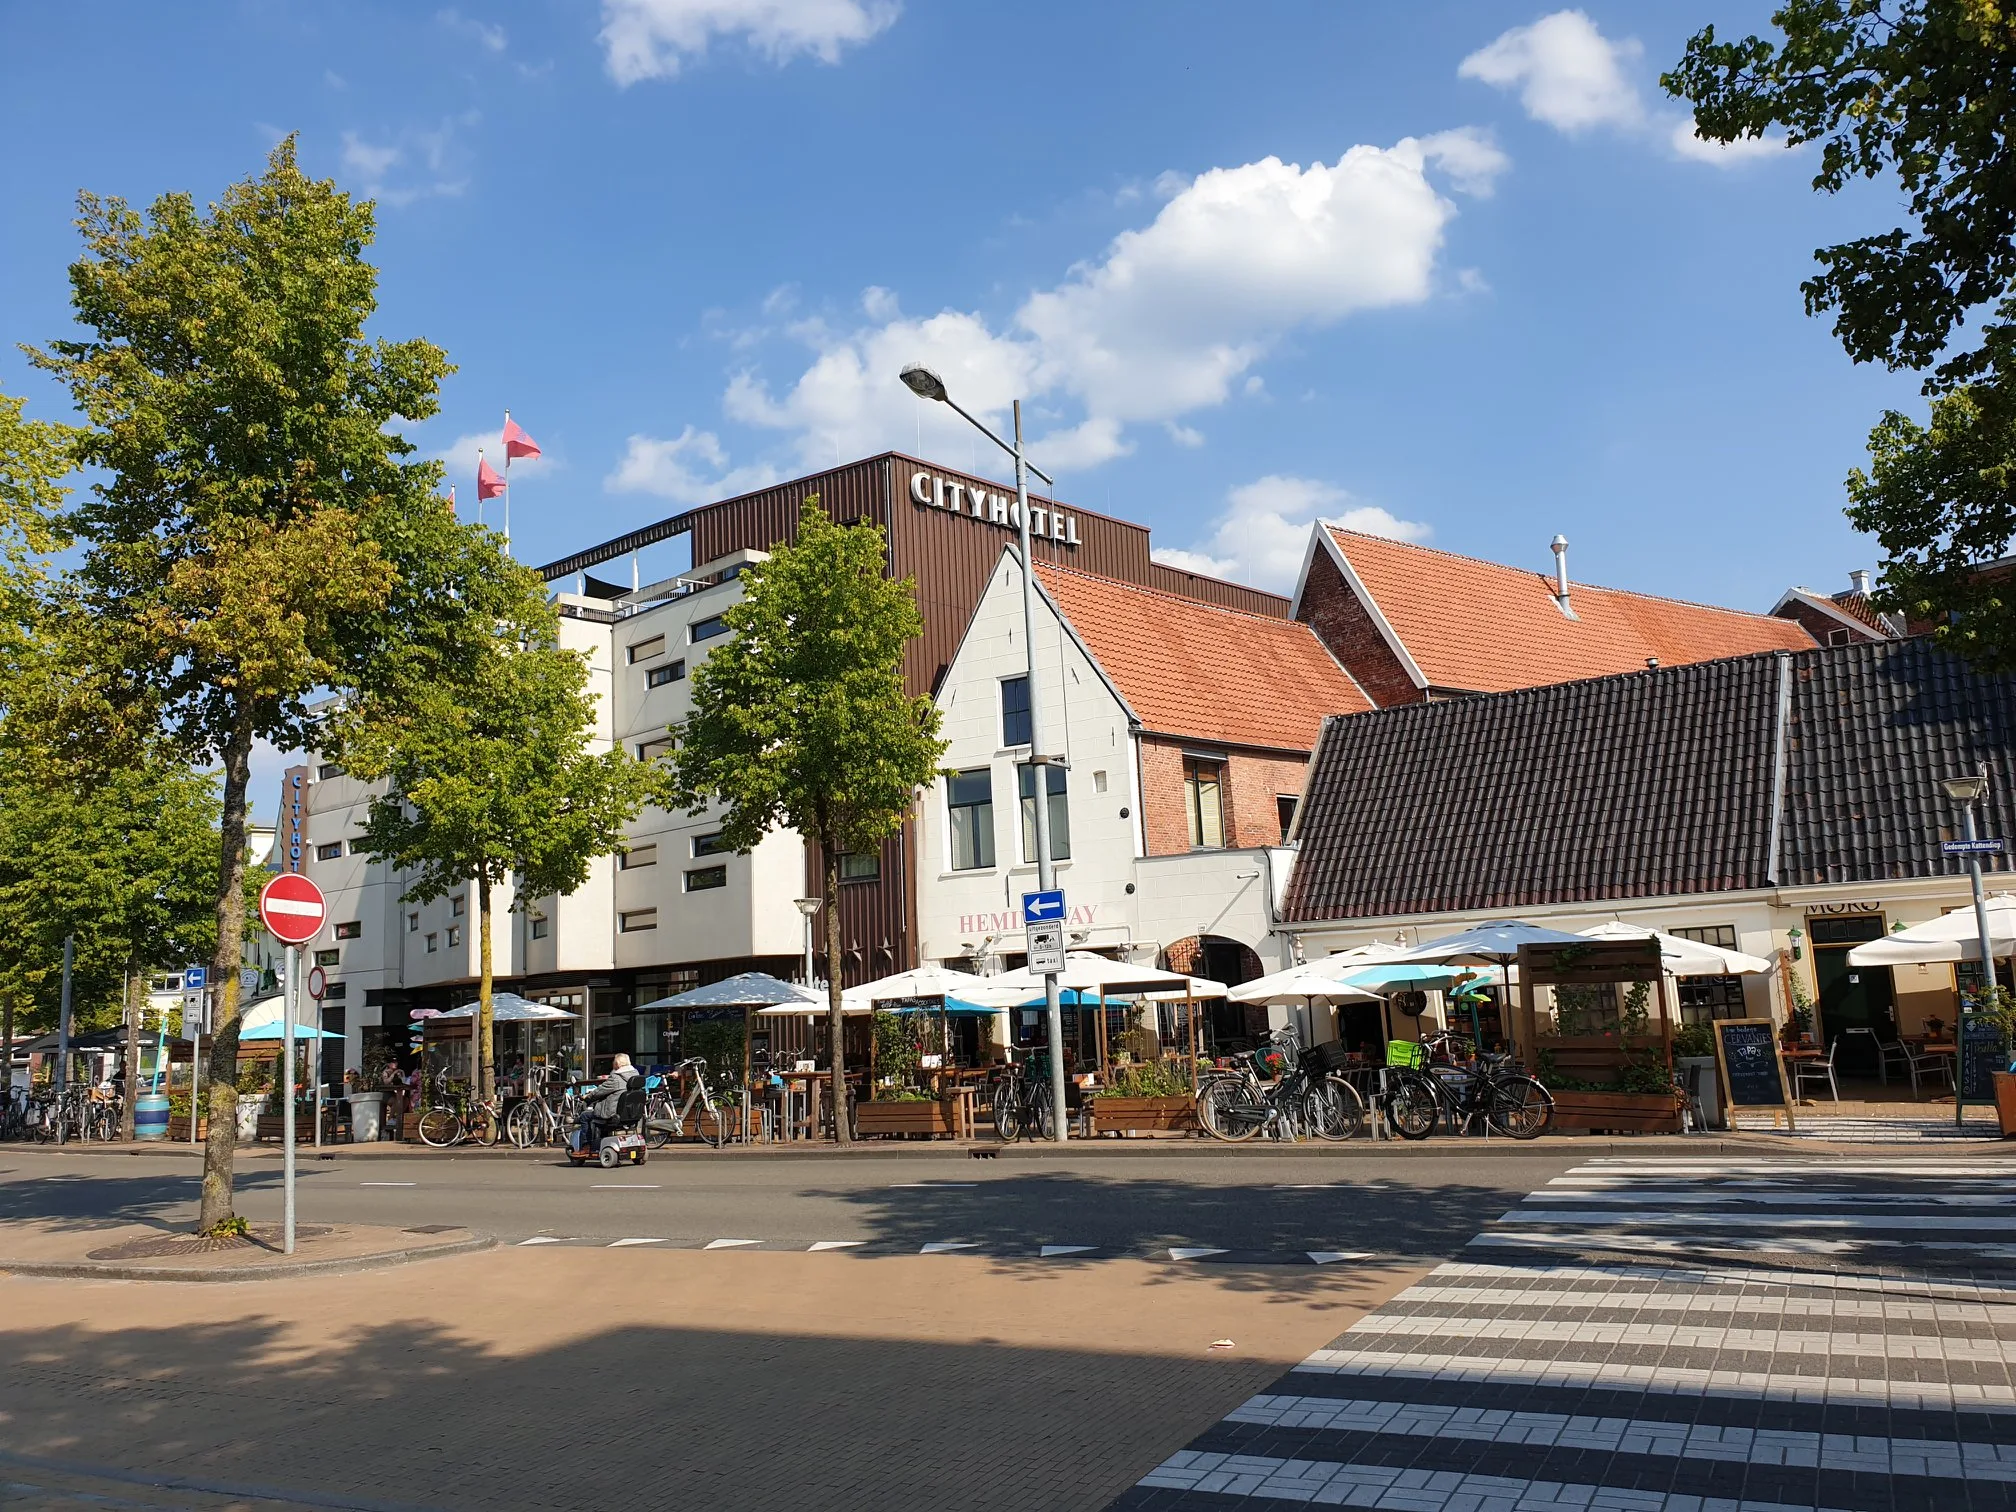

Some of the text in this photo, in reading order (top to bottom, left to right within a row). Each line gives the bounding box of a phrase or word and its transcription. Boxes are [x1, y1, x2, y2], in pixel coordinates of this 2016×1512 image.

[910, 471, 1082, 545] CITYHOTEL
[290, 775, 301, 872] CITYHOT
[1944, 841, 2001, 851] Gedempte Kattendiep
[960, 904, 1098, 934] HEMIAY
[1029, 923, 1059, 932] uitgezonderd
[1046, 956, 1059, 964] taxi
[1724, 1033, 1772, 1043] CERVANTES
